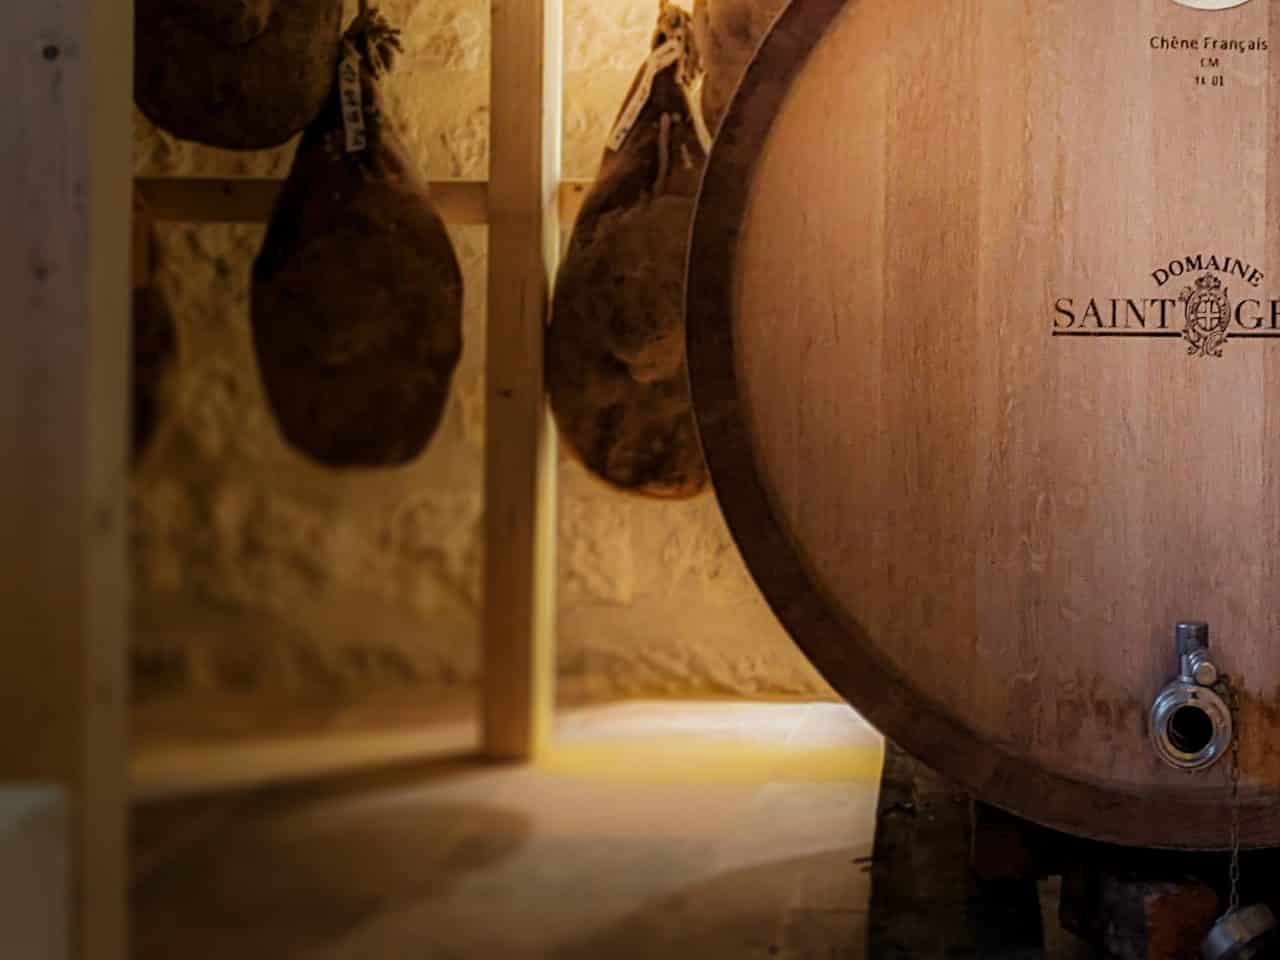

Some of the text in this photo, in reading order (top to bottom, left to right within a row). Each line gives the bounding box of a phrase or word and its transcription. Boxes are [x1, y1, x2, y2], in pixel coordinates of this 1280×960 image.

[1150, 36, 1269, 53] Chêne Français
[1151, 253, 1265, 288] DOMAINE
[1053, 297, 1176, 329] SAINT
